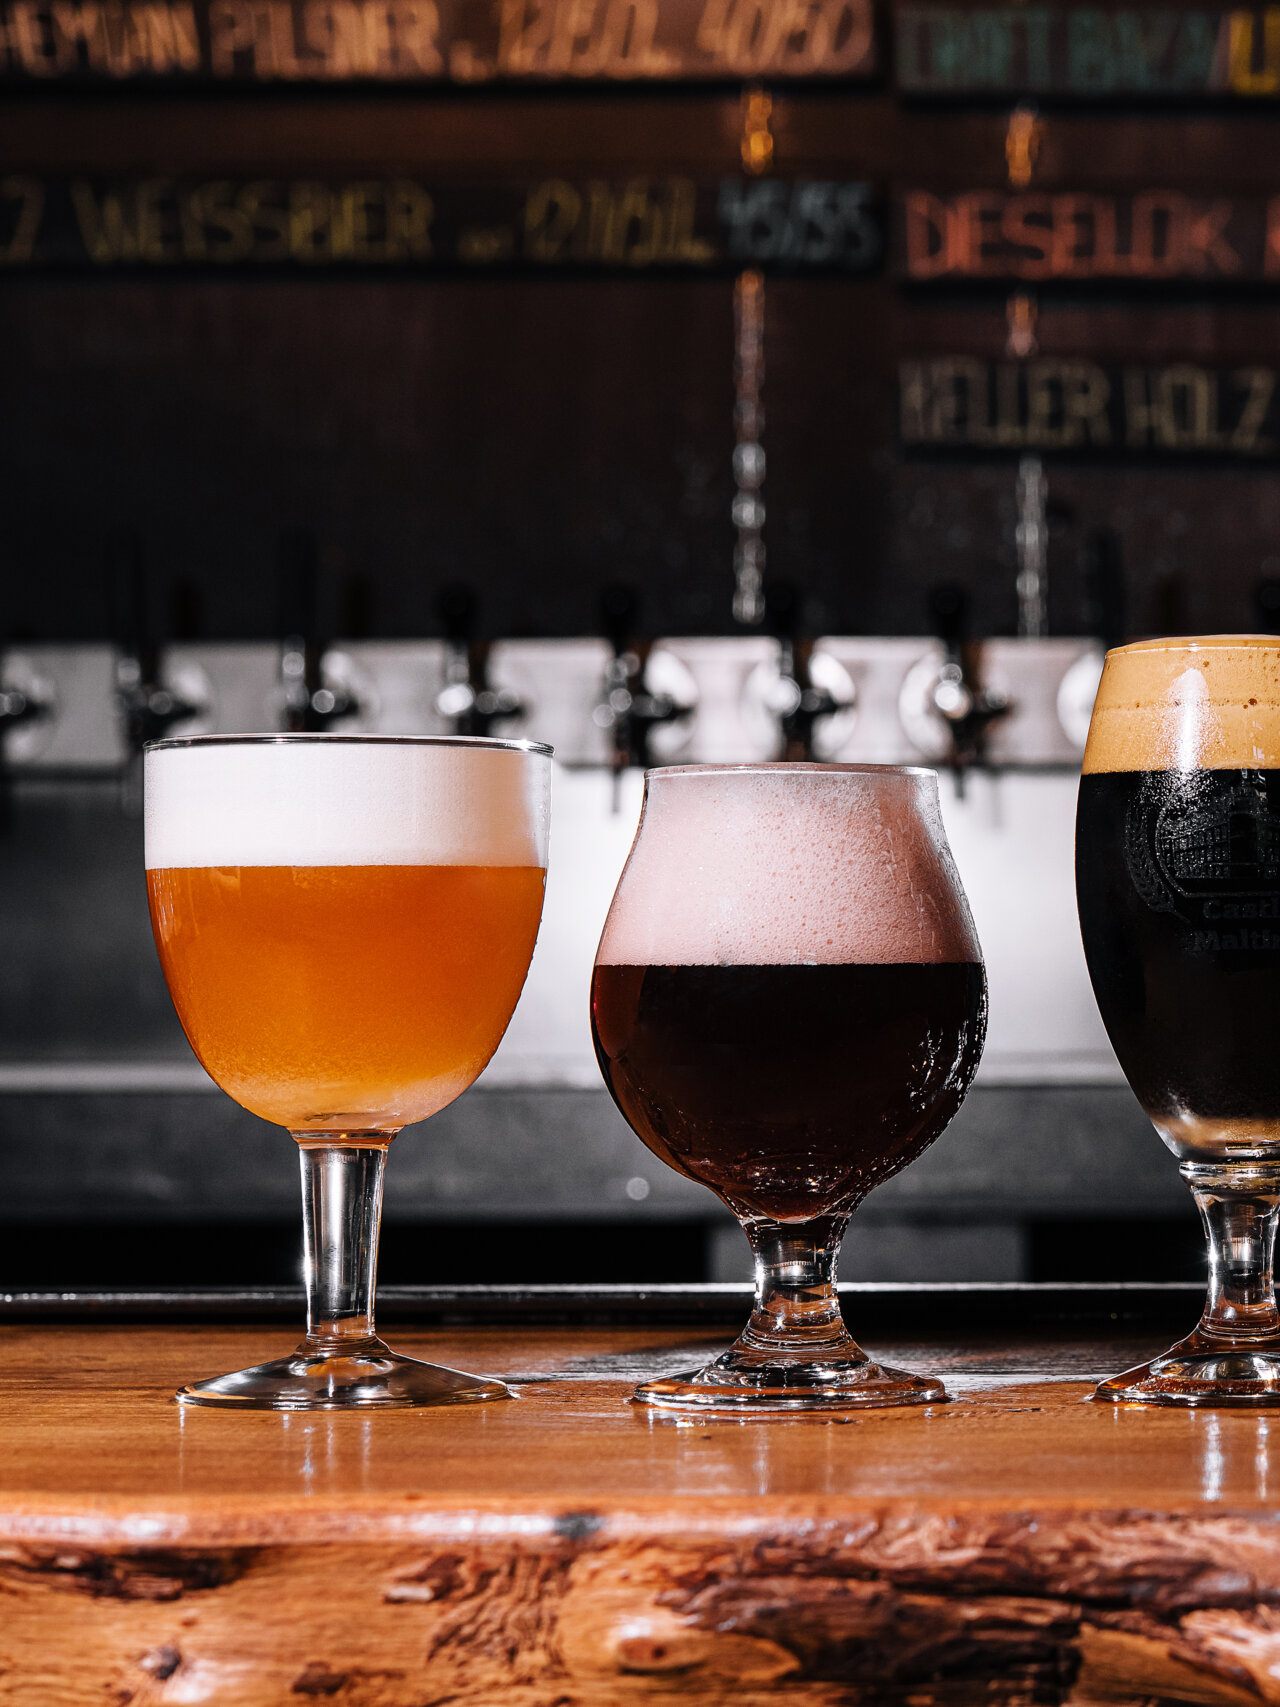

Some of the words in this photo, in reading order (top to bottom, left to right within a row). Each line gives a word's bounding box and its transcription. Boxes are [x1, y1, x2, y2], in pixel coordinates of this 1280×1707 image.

[209, 0, 444, 79] PILSNER
[74, 178, 434, 266] WEISSBIER
[900, 355, 1111, 450] KELLER
[1122, 361, 1279, 455] HOLZ
